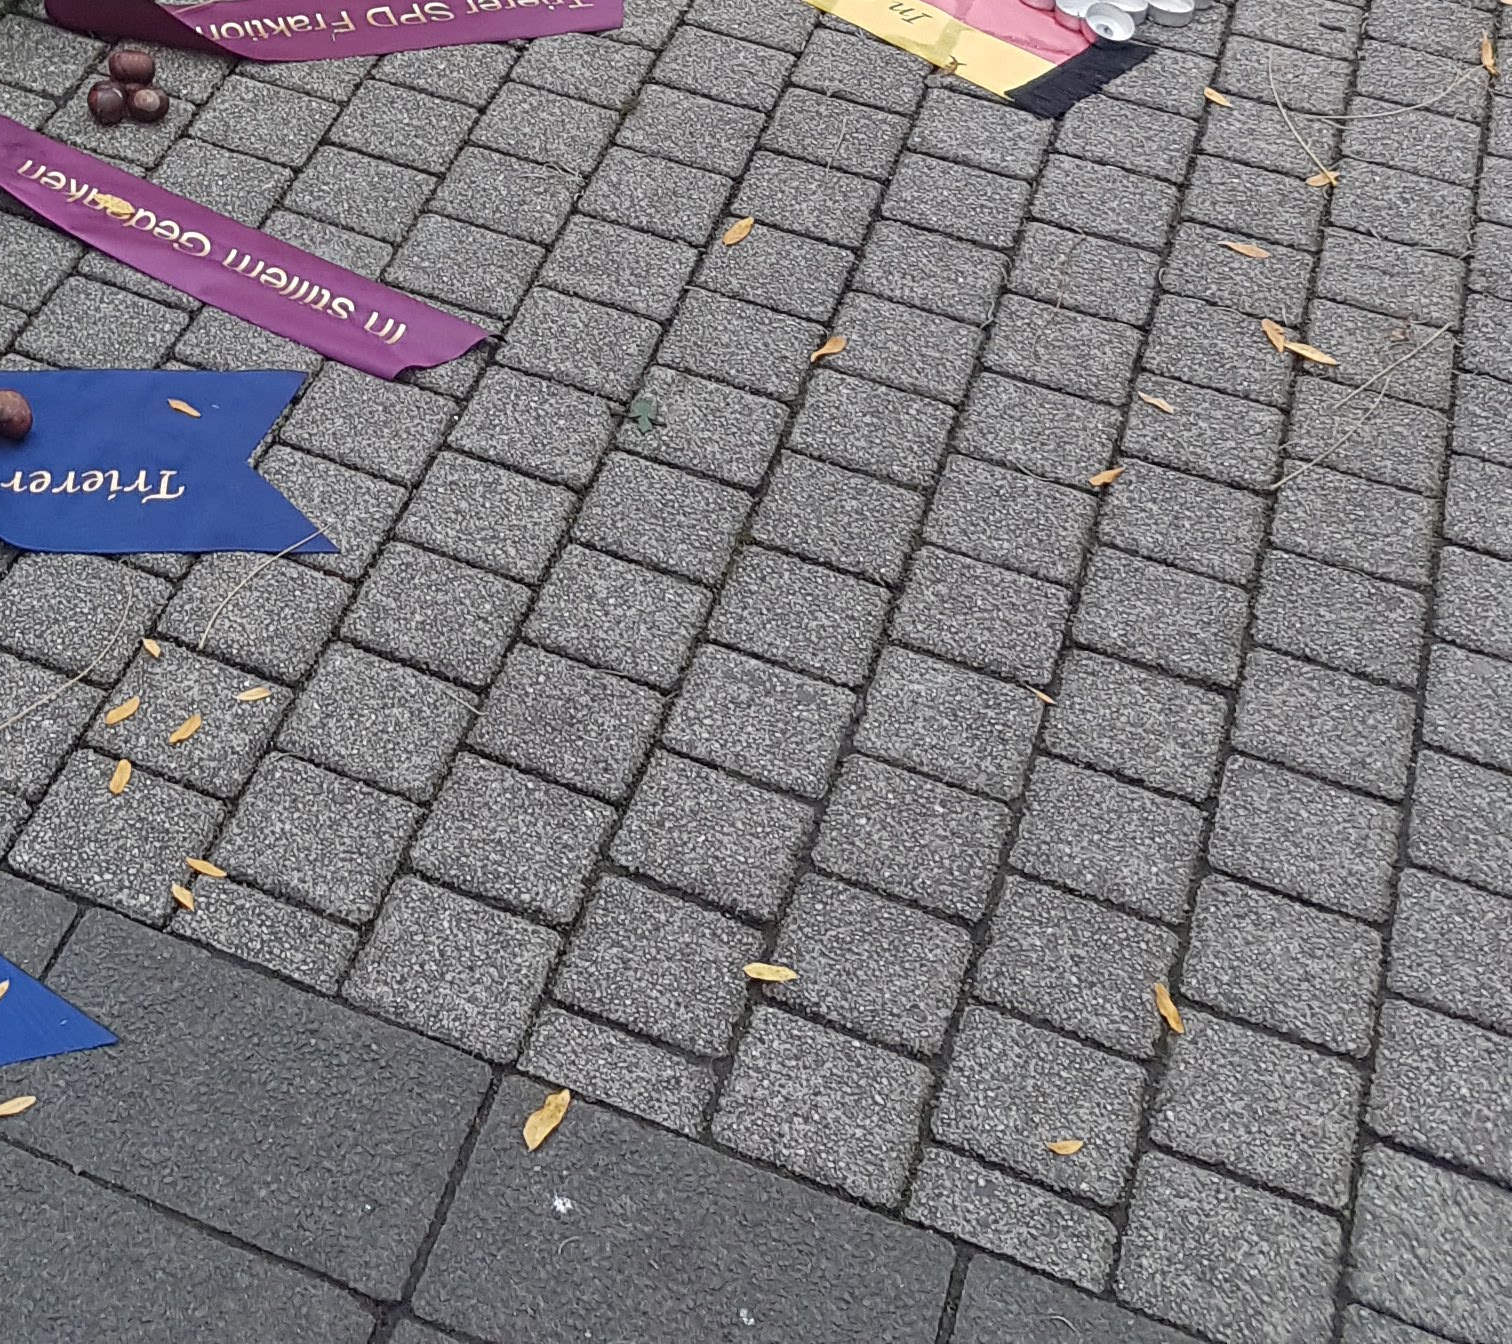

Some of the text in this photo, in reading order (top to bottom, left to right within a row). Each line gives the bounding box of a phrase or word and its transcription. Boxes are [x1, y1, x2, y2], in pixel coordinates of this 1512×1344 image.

[194, 10, 356, 43] Fraktion
[365, 0, 456, 28] SPD
[887, 0, 934, 26] In
[221, 246, 356, 319] stillem
[362, 310, 409, 347] In
[0, 467, 186, 505] Trierer
